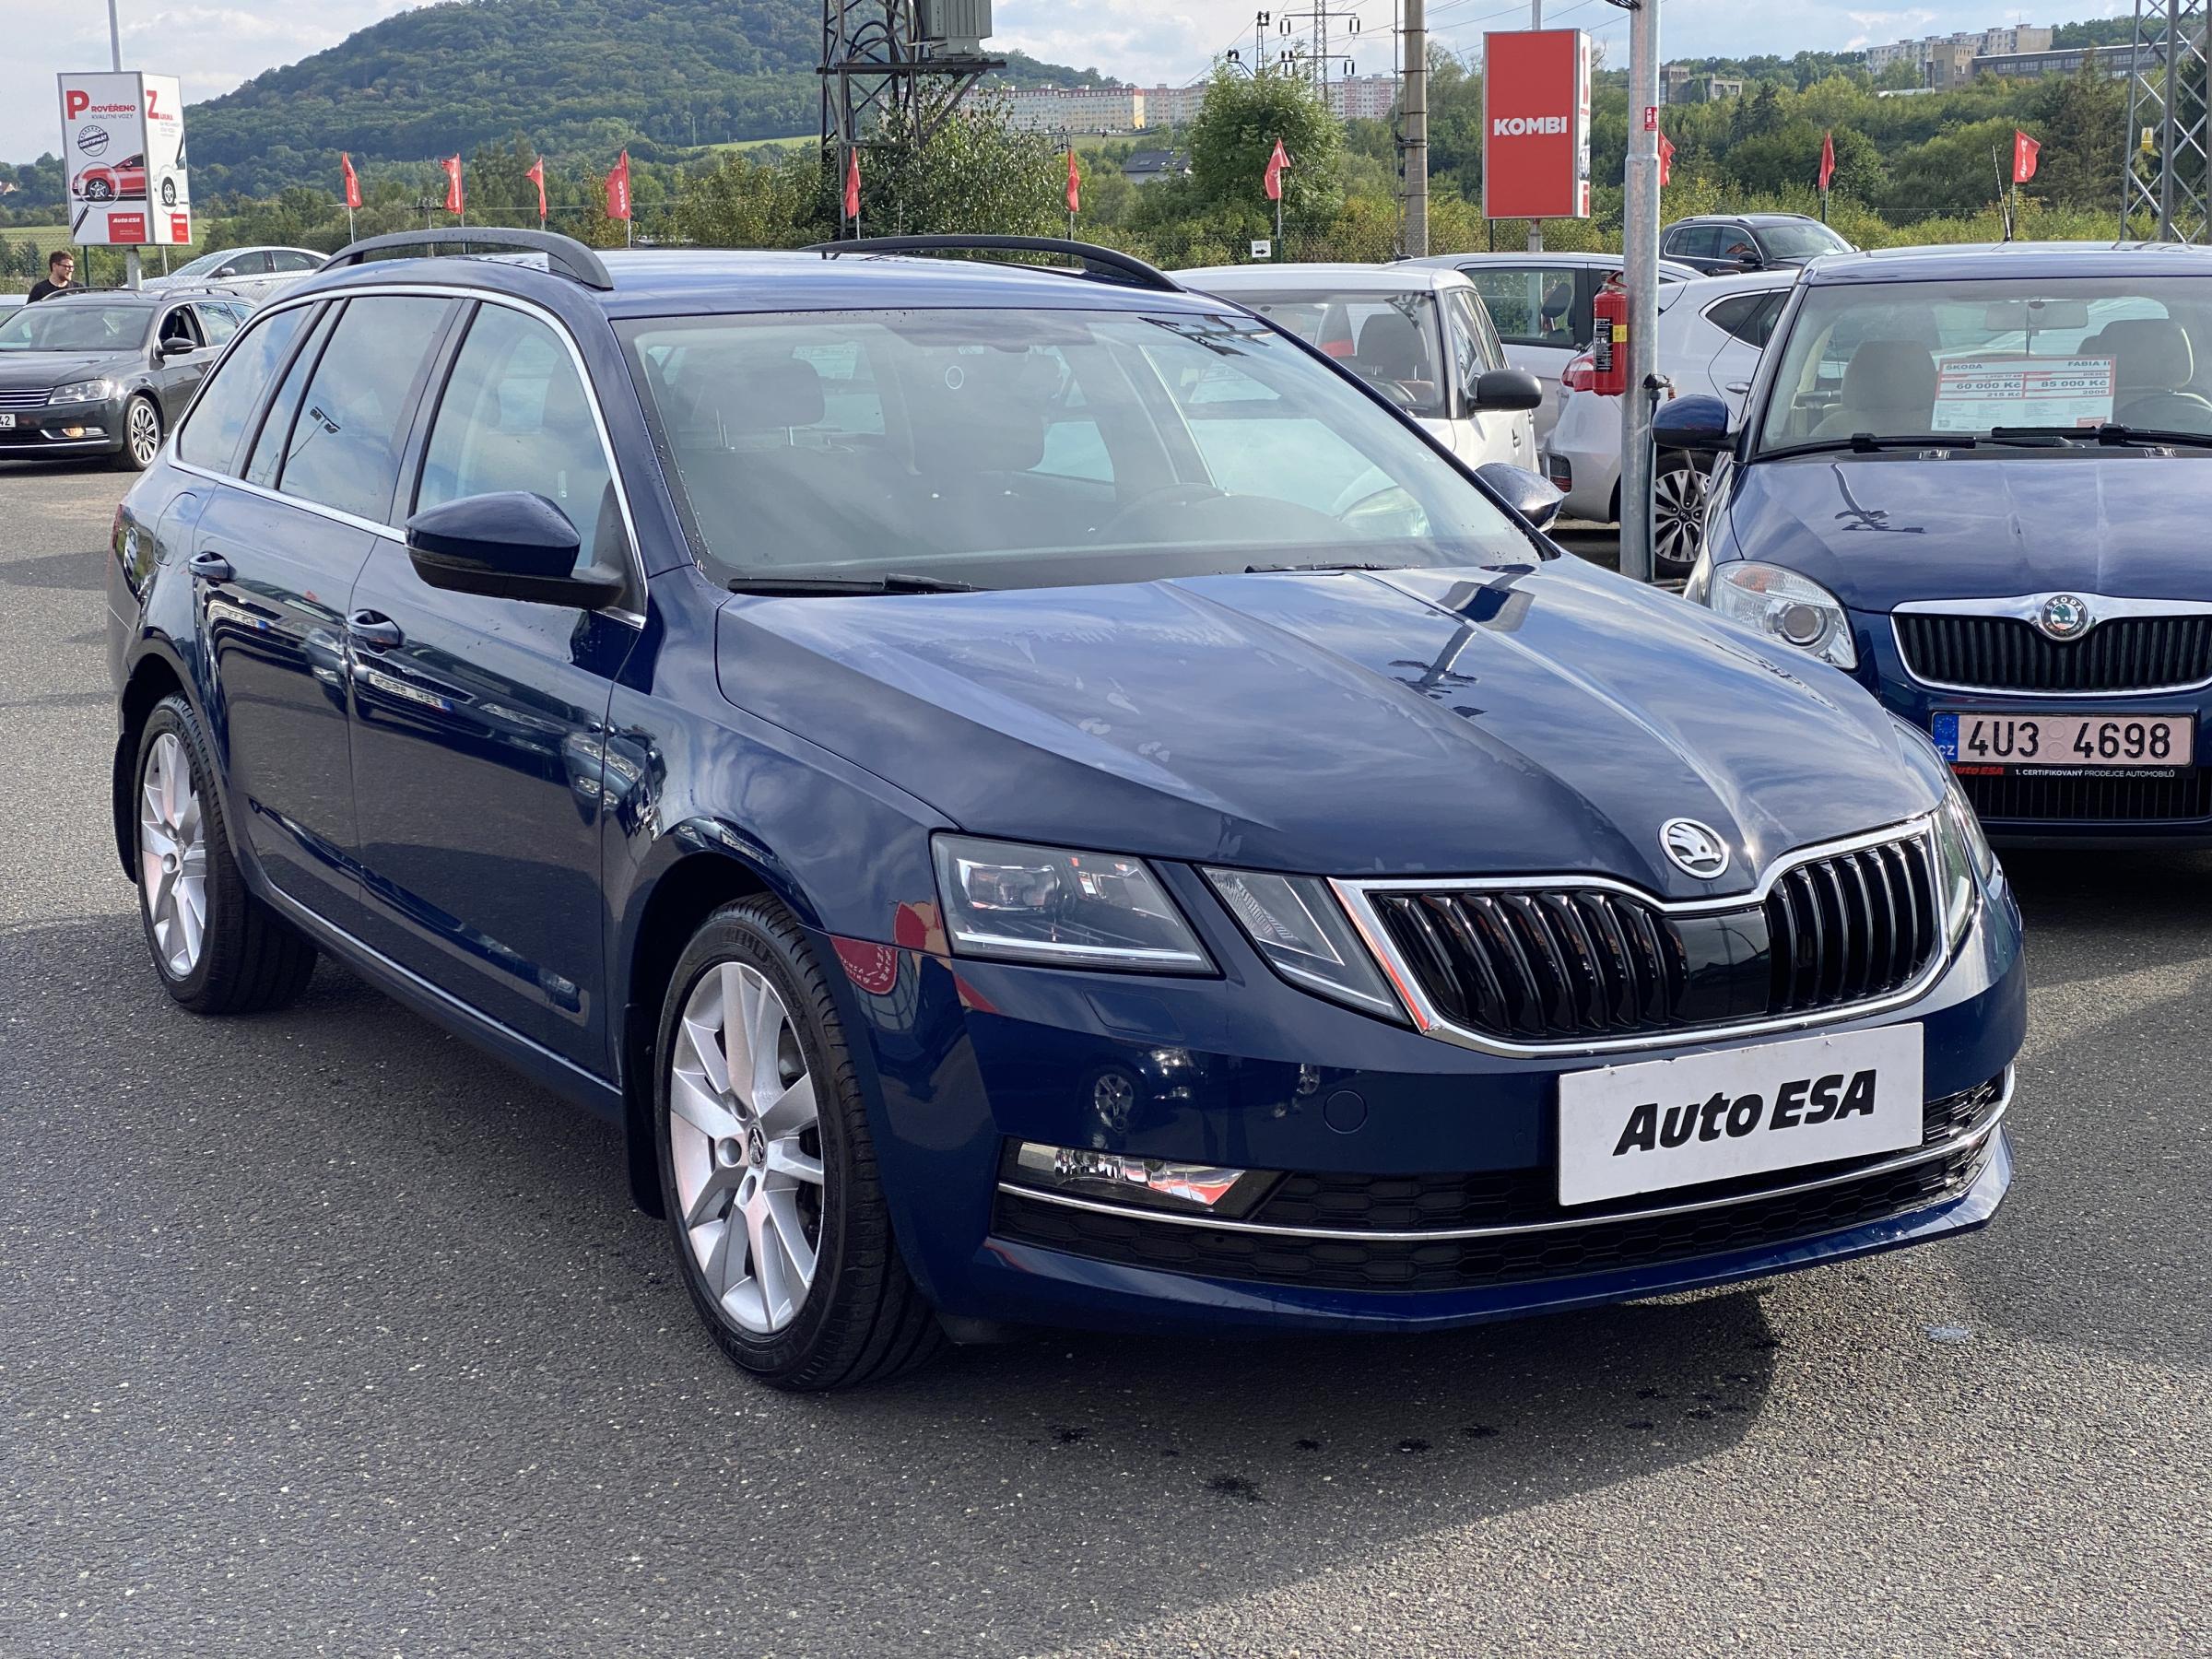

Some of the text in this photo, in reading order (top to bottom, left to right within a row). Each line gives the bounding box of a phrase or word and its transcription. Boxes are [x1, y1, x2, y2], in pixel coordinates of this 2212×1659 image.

[1493, 116, 1567, 135] KOMBI
[1968, 721, 2171, 759] 4U3 4698
[1938, 745, 1955, 756] CZ
[2125, 769, 2175, 778] AUTOMOBILŮ
[1613, 1069, 1877, 1156] Auto ESA
